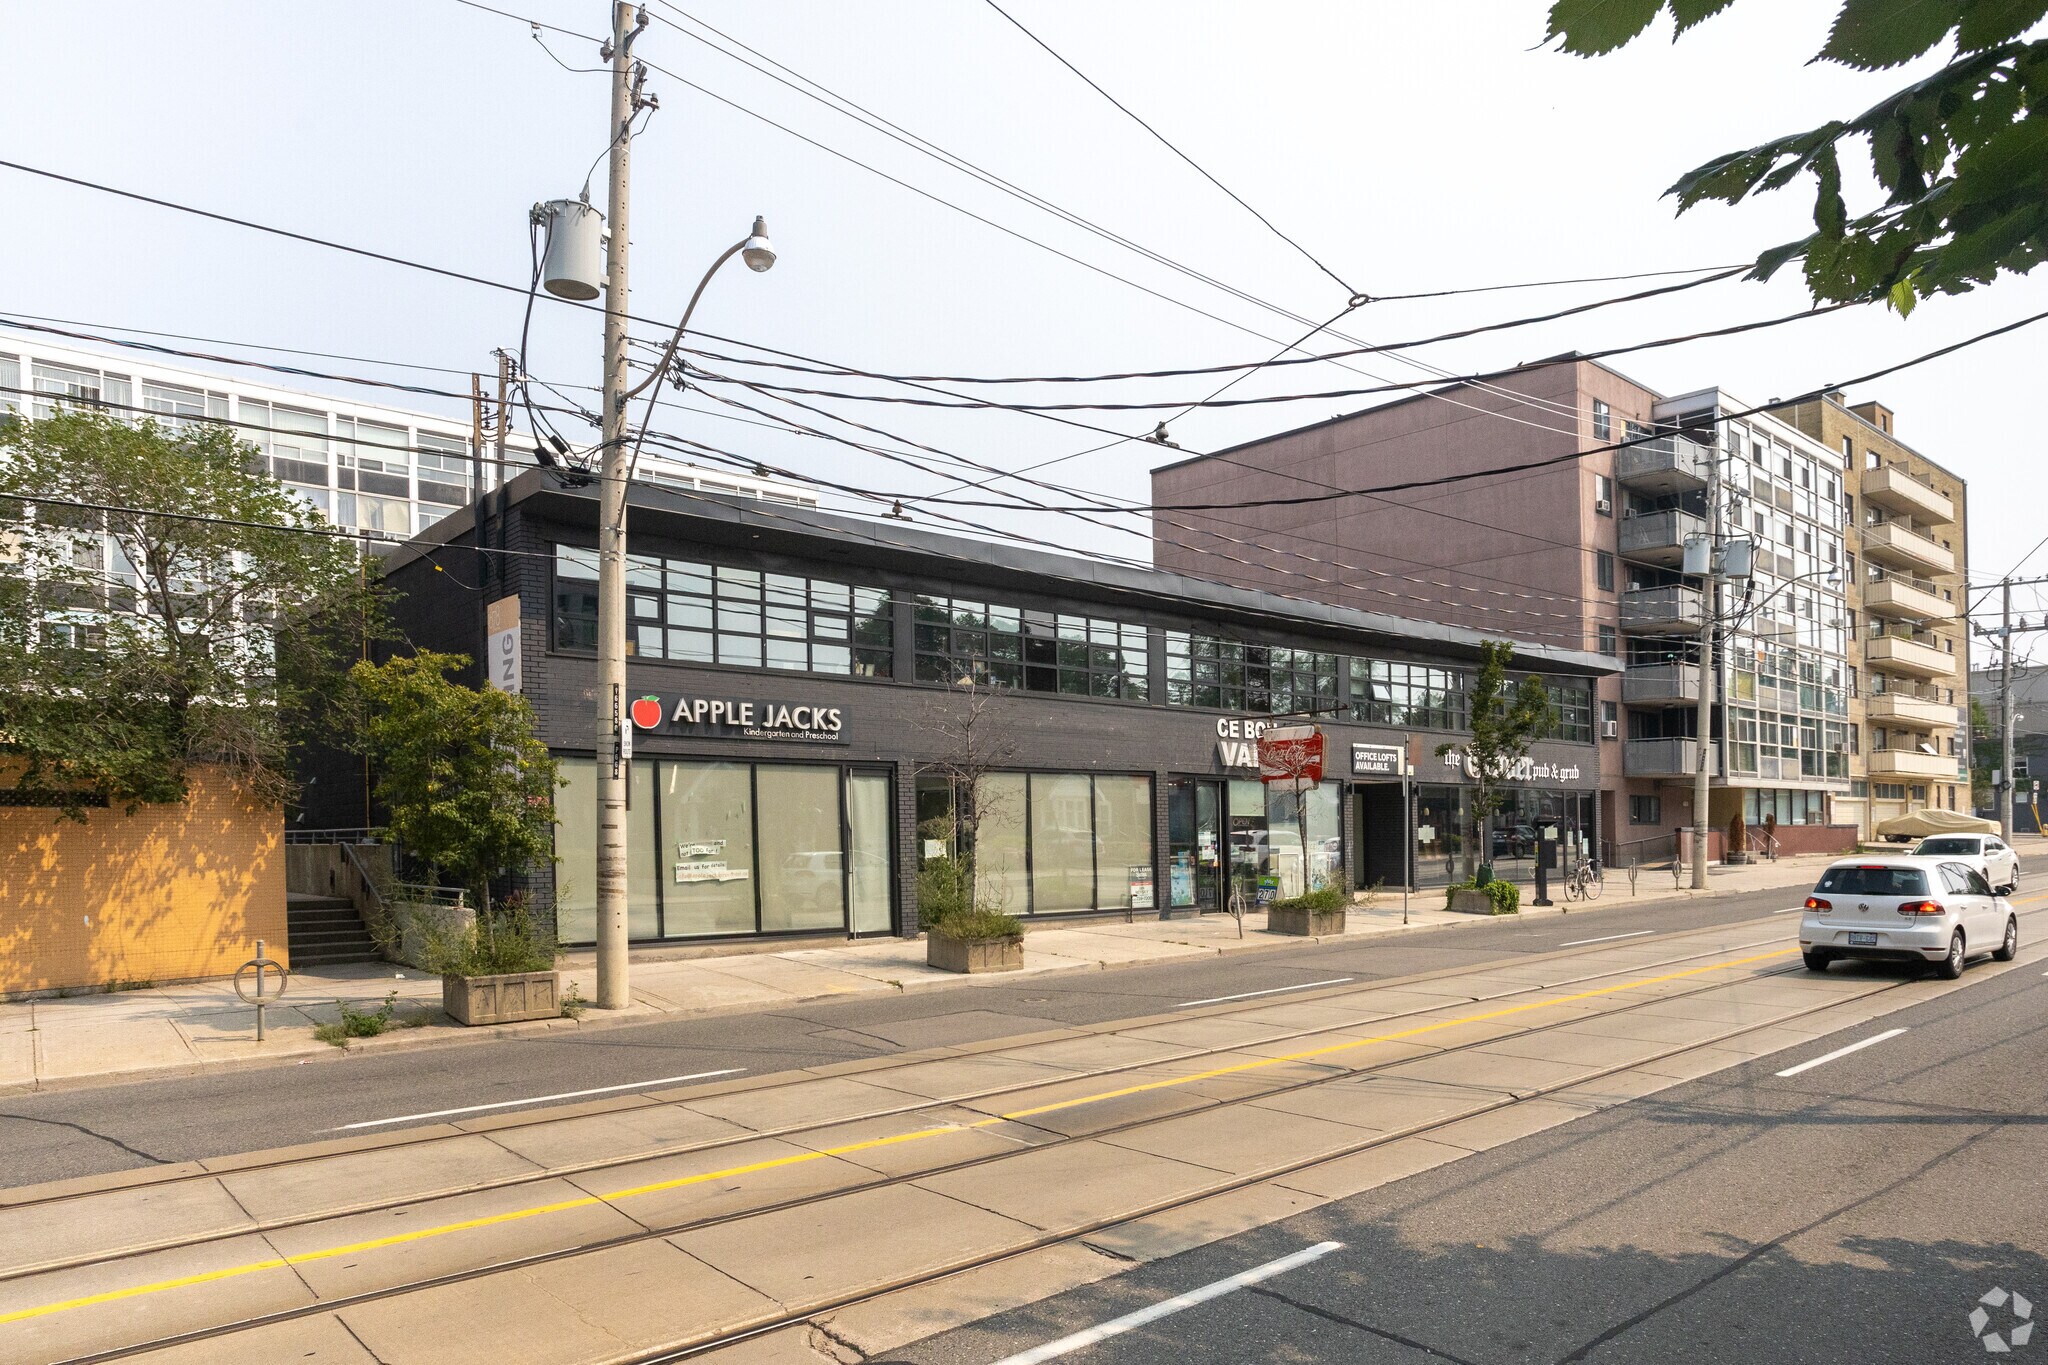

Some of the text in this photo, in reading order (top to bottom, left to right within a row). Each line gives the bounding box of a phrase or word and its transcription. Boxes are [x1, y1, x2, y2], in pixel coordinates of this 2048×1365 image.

[671, 697, 842, 731] APPLE JACKS
[743, 727, 839, 740] Kindergarten and Preschool
[1217, 718, 1239, 738] CE
[1355, 751, 1397, 763] OFFICE LOFTS
[1355, 761, 1390, 772] AVAILABLE.
[1444, 749, 1460, 770] the
[1533, 762, 1549, 780] pub
[1551, 763, 1559, 780] &
[1560, 764, 1580, 783] grub
